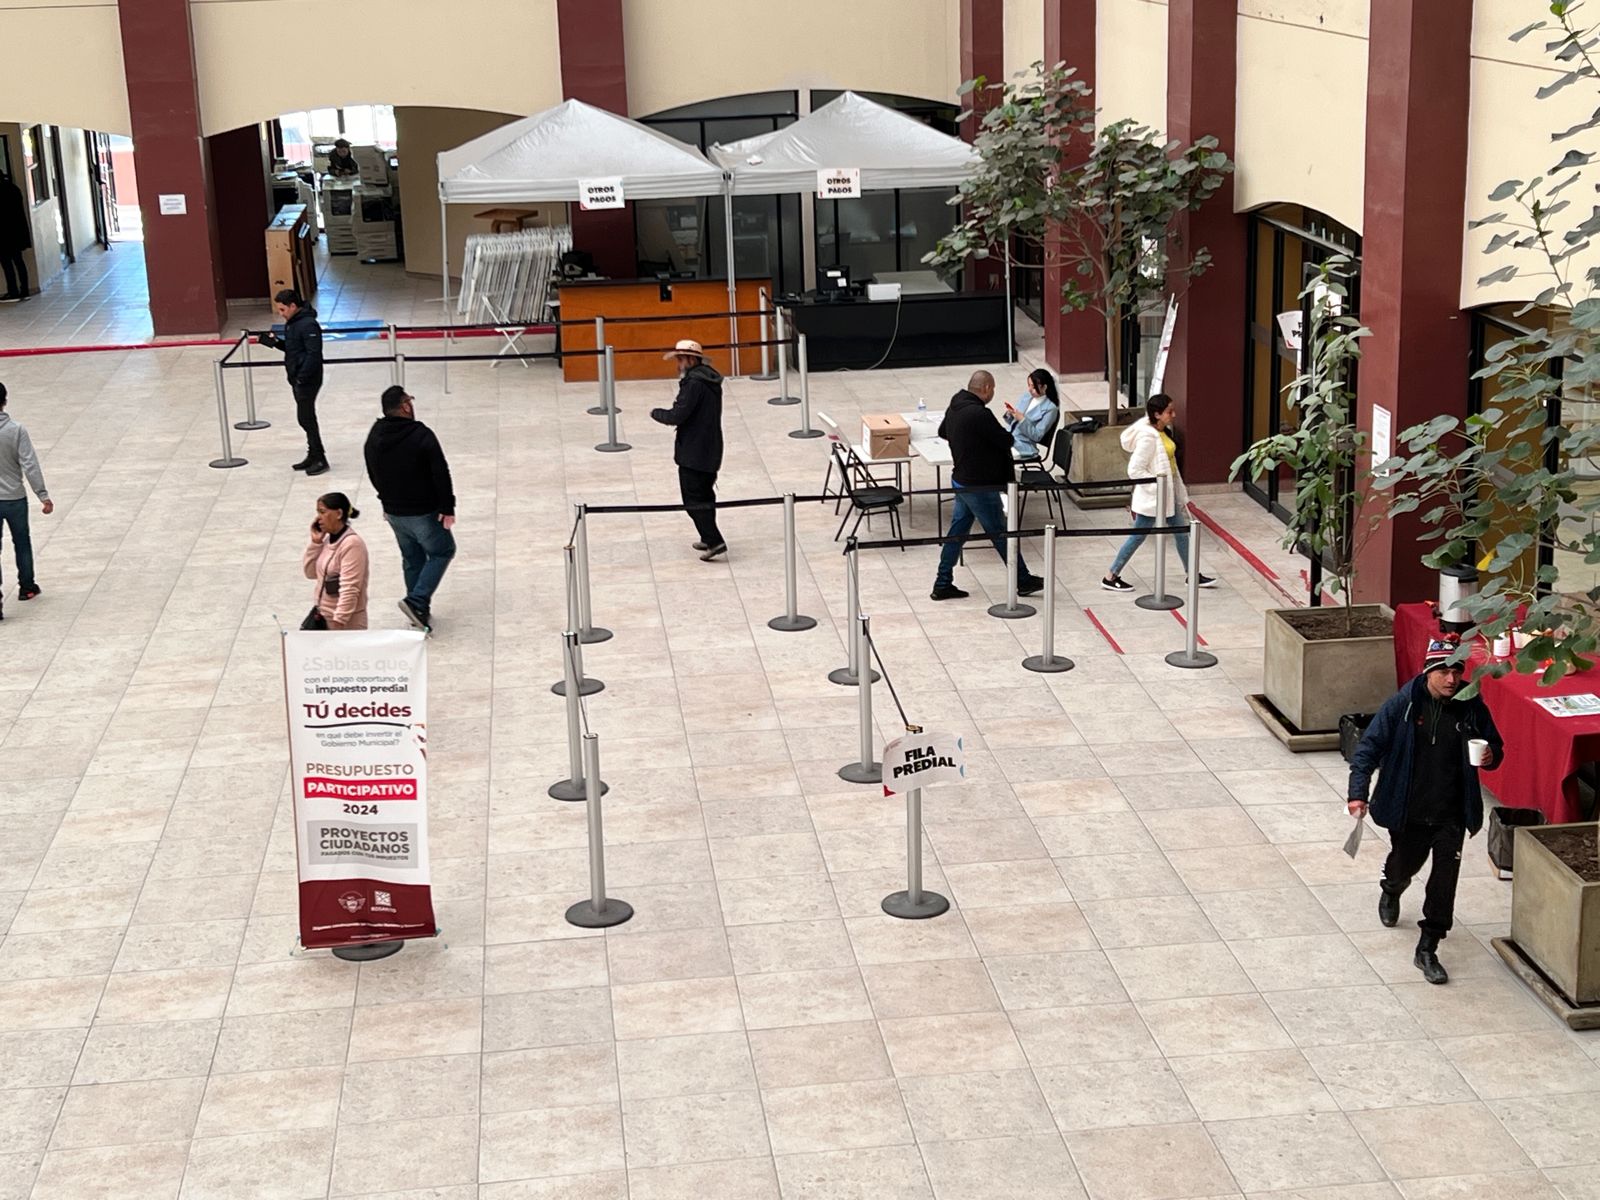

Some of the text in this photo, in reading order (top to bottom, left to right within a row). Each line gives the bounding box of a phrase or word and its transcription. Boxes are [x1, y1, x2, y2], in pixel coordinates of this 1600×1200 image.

[827, 177, 852, 185] OTROS
[587, 186, 615, 194] OTROS
[322, 675, 330, 683] el
[332, 676, 354, 684] pago
[356, 675, 396, 684] oportuno
[397, 675, 409, 683] de
[315, 684, 368, 696] impuesto
[370, 683, 408, 695] predial
[303, 700, 412, 719] TÚ decides
[344, 731, 364, 739] debe
[321, 738, 400, 747] Gobierno Municipal?
[905, 746, 936, 762] FILA
[306, 763, 414, 777] PRESUPUESTO
[893, 757, 957, 779] PREDIAL
[307, 782, 414, 796] PARTICIPATIVO
[343, 803, 378, 815] 2024
[320, 828, 408, 842] PROYECTOS
[320, 840, 410, 854] CIUDADANOS
